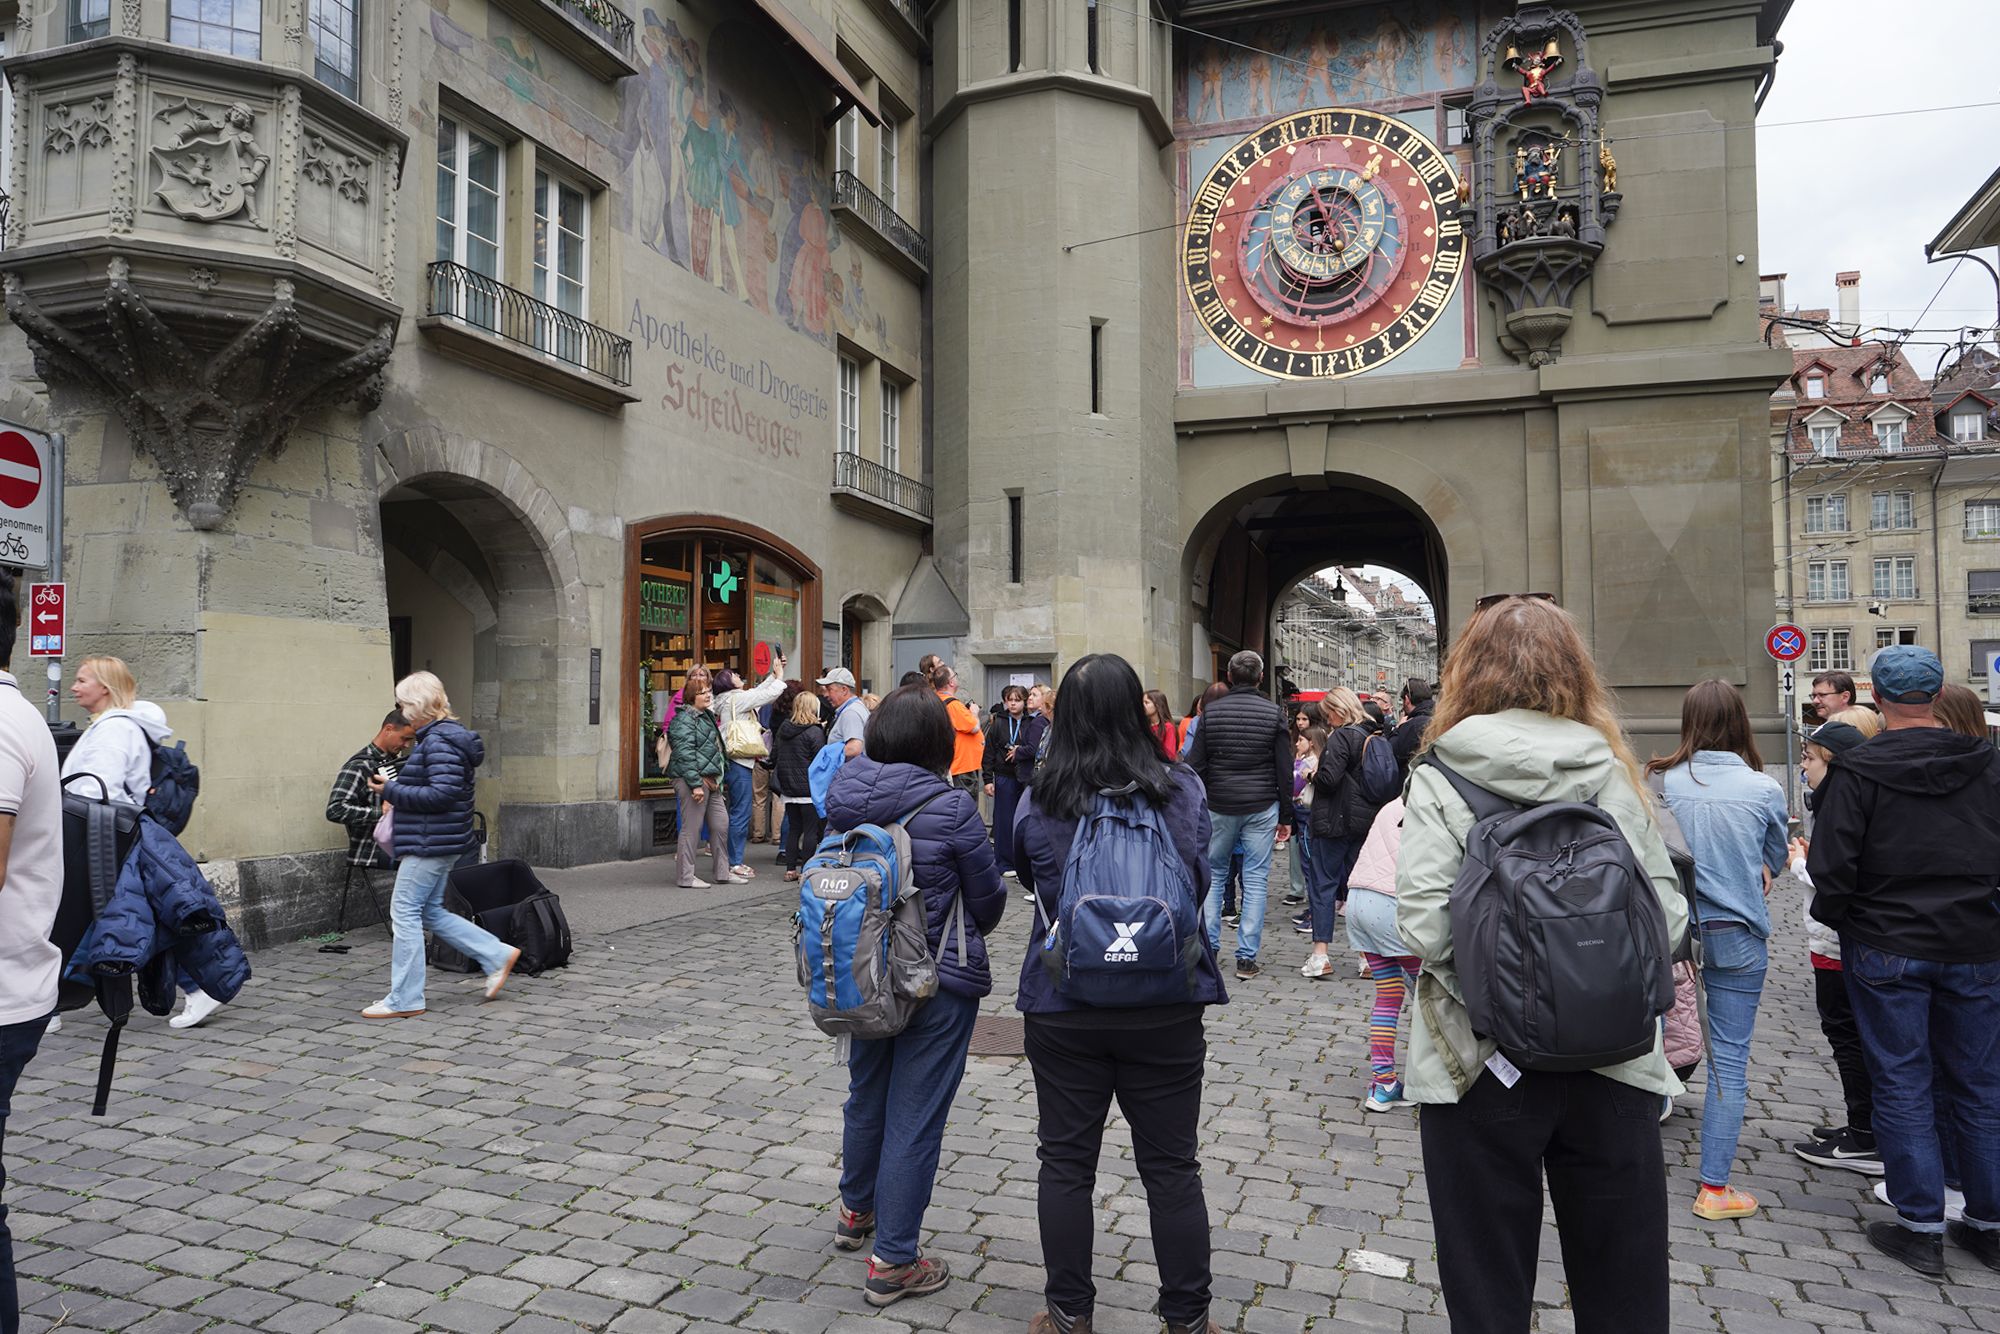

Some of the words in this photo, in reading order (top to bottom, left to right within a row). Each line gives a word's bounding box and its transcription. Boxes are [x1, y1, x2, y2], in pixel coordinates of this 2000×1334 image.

[628, 298, 726, 374] Apotheke
[730, 361, 754, 388] und
[759, 360, 828, 421] Drogerie
[662, 363, 802, 459] Scheidegger
[1104, 953, 1140, 962] CEFGE
[1576, 939, 1605, 947] QUECHUA
